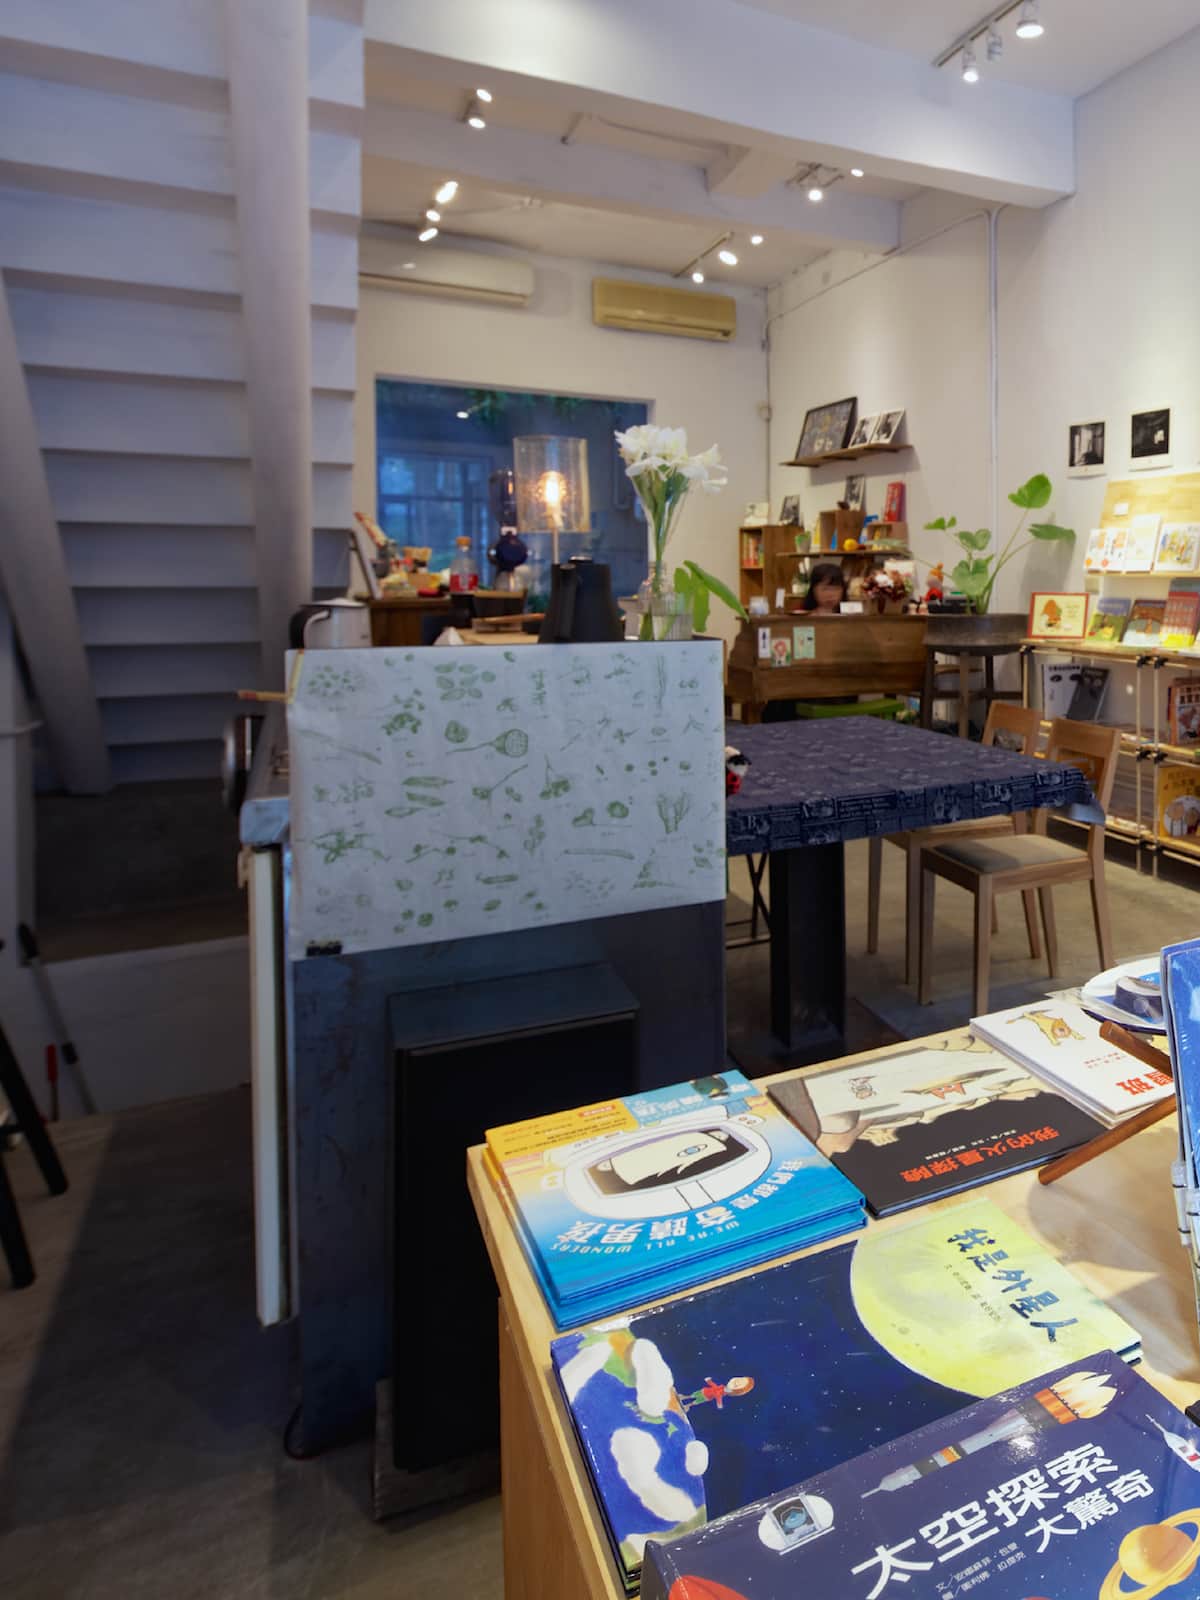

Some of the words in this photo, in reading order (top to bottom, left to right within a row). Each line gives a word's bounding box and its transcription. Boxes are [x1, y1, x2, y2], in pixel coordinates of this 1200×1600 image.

[900, 1126, 1060, 1183] 我的火星探險
[551, 1243, 632, 1254] WONDERS
[947, 1228, 1079, 1343] 我是外星人
[851, 1443, 1118, 1600] 太空探索
[1025, 1469, 1154, 1553] 大驚奇
